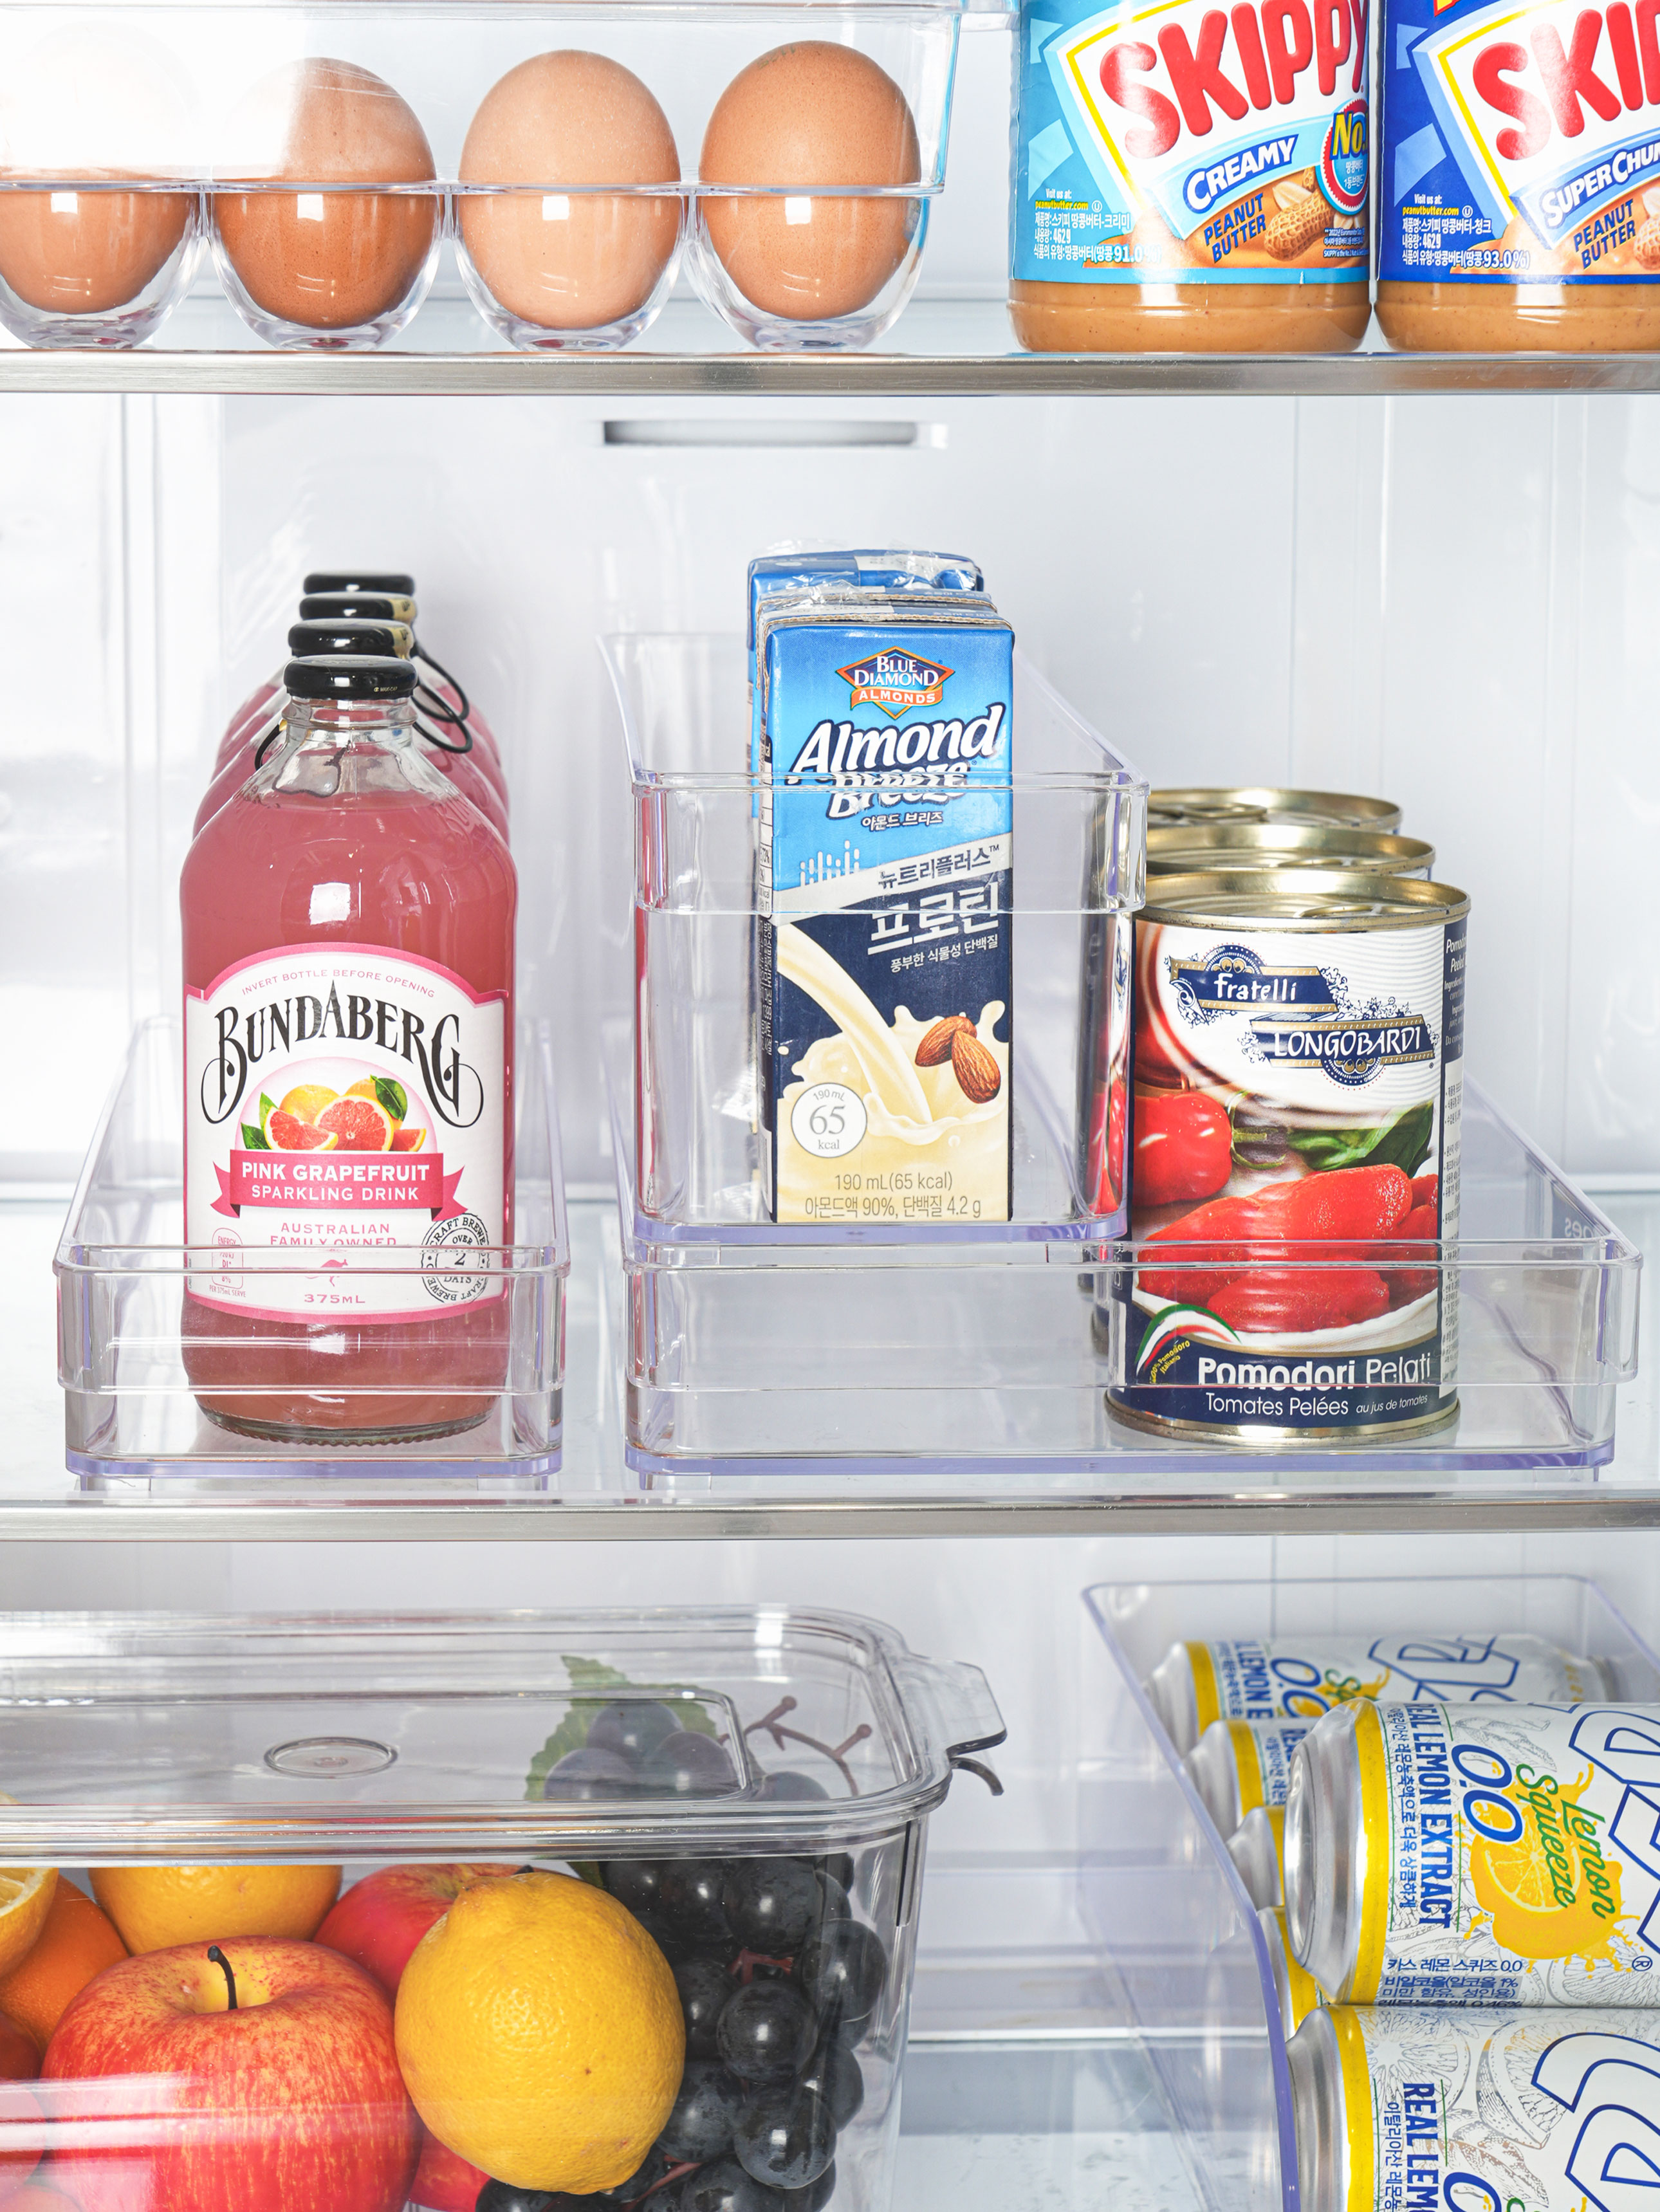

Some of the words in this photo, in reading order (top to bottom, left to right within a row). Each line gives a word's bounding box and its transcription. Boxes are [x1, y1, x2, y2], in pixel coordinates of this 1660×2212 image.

[1185, 138, 1298, 212] CREAMY
[1035, 199, 1089, 210] peanutbutter.com
[1046, 189, 1055, 199] Visit
[1056, 190, 1063, 199] us
[1064, 189, 1072, 199] at:
[1414, 194, 1426, 205] Visit
[1426, 196, 1434, 205] us
[1434, 195, 1443, 205] at:
[1204, 193, 1264, 246] PEANUT
[1402, 205, 1459, 216] peanutbutter.com
[1573, 198, 1634, 253] PEANUT
[1212, 217, 1267, 264] BUTTER
[1581, 219, 1636, 270] BUTTER
[854, 669, 939, 687] DIAMOND
[877, 656, 918, 673] BLUE
[859, 689, 936, 705] ALMONDS
[788, 703, 1005, 781] Almond
[862, 813, 901, 831] 아몬드
[903, 811, 943, 826] 브리즈
[878, 847, 991, 889] 뉴트리플러스
[868, 881, 999, 955] 프로틴
[890, 952, 925, 973] 풍부한
[927, 942, 961, 962] 식물성
[964, 934, 998, 955] 단백질
[241, 975, 279, 995] INVERT
[282, 970, 328, 982] BOTTLE
[333, 969, 382, 981] BEFORE
[385, 975, 436, 999] OPENING
[1213, 973, 1297, 1001] fratelli
[201, 979, 484, 1129] BUNDABERG
[1274, 1026, 1421, 1058] LONGOBARDI
[813, 1089, 831, 1101] 190
[831, 1090, 846, 1102] mL
[809, 1104, 845, 1136] 65
[818, 1139, 840, 1150] kcal
[241, 1162, 286, 1181] PINK
[293, 1163, 430, 1183] GRAPEFRUIT
[834, 1174, 862, 1191] 190
[917, 1170, 954, 1192] kcal)
[252, 1185, 354, 1201] SPARKLING
[362, 1186, 419, 1201] DRINK
[805, 1196, 858, 1219] 아몬드액
[862, 1197, 899, 1219] 90%,
[903, 1195, 943, 1217] 단백질
[281, 1222, 390, 1235] AUSTRALIAN
[452, 1234, 473, 1246] OVER
[462, 1217, 486, 1246] BREWE
[454, 1253, 466, 1266] 2
[208, 1284, 217, 1293] PER
[217, 1286, 232, 1296] 375mL
[232, 1288, 246, 1298] SERVE
[1198, 1357, 1356, 1391] Pomodori
[1365, 1352, 1432, 1388] Pelati
[1205, 1392, 1284, 1415] Tomates
[1289, 1396, 1349, 1416] Pelées
[1356, 1405, 1370, 1414] au
[1369, 1401, 1383, 1415] jus
[1385, 1399, 1397, 1411] de
[1398, 1394, 1428, 1409] tomates
[1411, 1732, 1452, 1805] LEMON
[1394, 1744, 1416, 1823] 레몬농축액으로
[1451, 1744, 1524, 1843] 0.0
[1399, 1827, 1417, 1853] 더욱
[1515, 1763, 1577, 1908] Squeeze
[1419, 1812, 1453, 1929] EXTRACT
[1561, 1799, 1617, 1920] Lemon
[1399, 1856, 1417, 1908] 상큼하게
[1387, 1958, 1417, 1971] 카스
[1420, 1958, 1451, 1972] 레몬
[1452, 1959, 1499, 1972] 스퀴즈
[1500, 1960, 1523, 1973] 0.0
[1383, 1987, 1415, 1998] 미만
[1500, 1977, 1519, 1988] 1%
[1403, 2083, 1439, 2148] REAL
[1383, 2101, 1403, 2168] 이탈리아산
[1406, 2153, 1439, 2212] LEM
